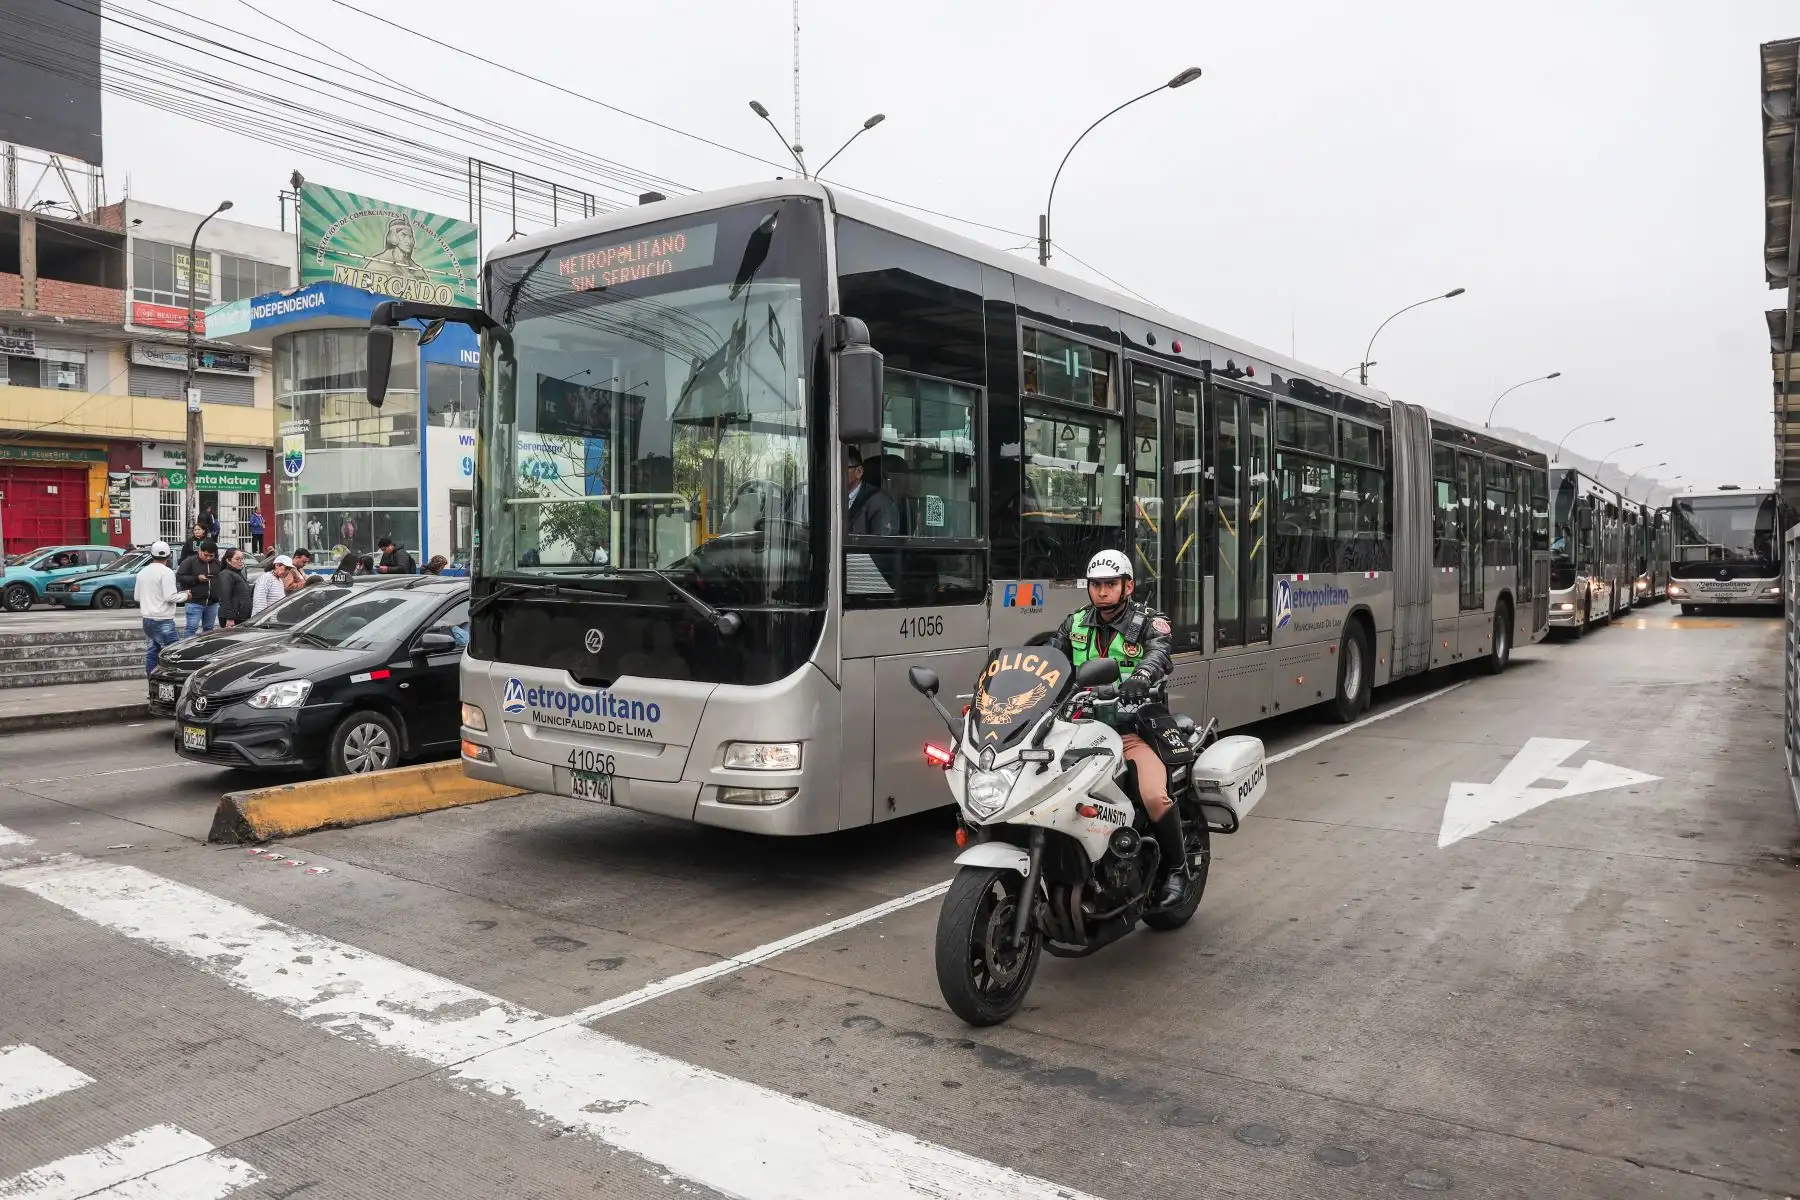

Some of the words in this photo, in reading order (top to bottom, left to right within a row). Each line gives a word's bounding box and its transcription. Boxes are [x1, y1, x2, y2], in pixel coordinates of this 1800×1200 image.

[350, 209, 400, 220] COMERCIANTES
[559, 233, 685, 276] METROPOLITANO
[333, 265, 455, 306] MERCADO
[571, 275, 595, 292] SIN
[602, 259, 672, 286] SERVICIO
[218, 475, 257, 486] Natura
[334, 574, 346, 582] TAXI
[1087, 558, 1120, 574] POLICIA
[900, 615, 944, 639] 41056
[978, 652, 1061, 689] POLICIA
[502, 677, 661, 723] Metropolitano
[532, 711, 606, 732] MUNICIPALIDAD
[608, 722, 623, 735] DE
[626, 723, 653, 739] LIMA
[567, 748, 615, 775] 41056
[1238, 763, 1265, 802] POLICIA
